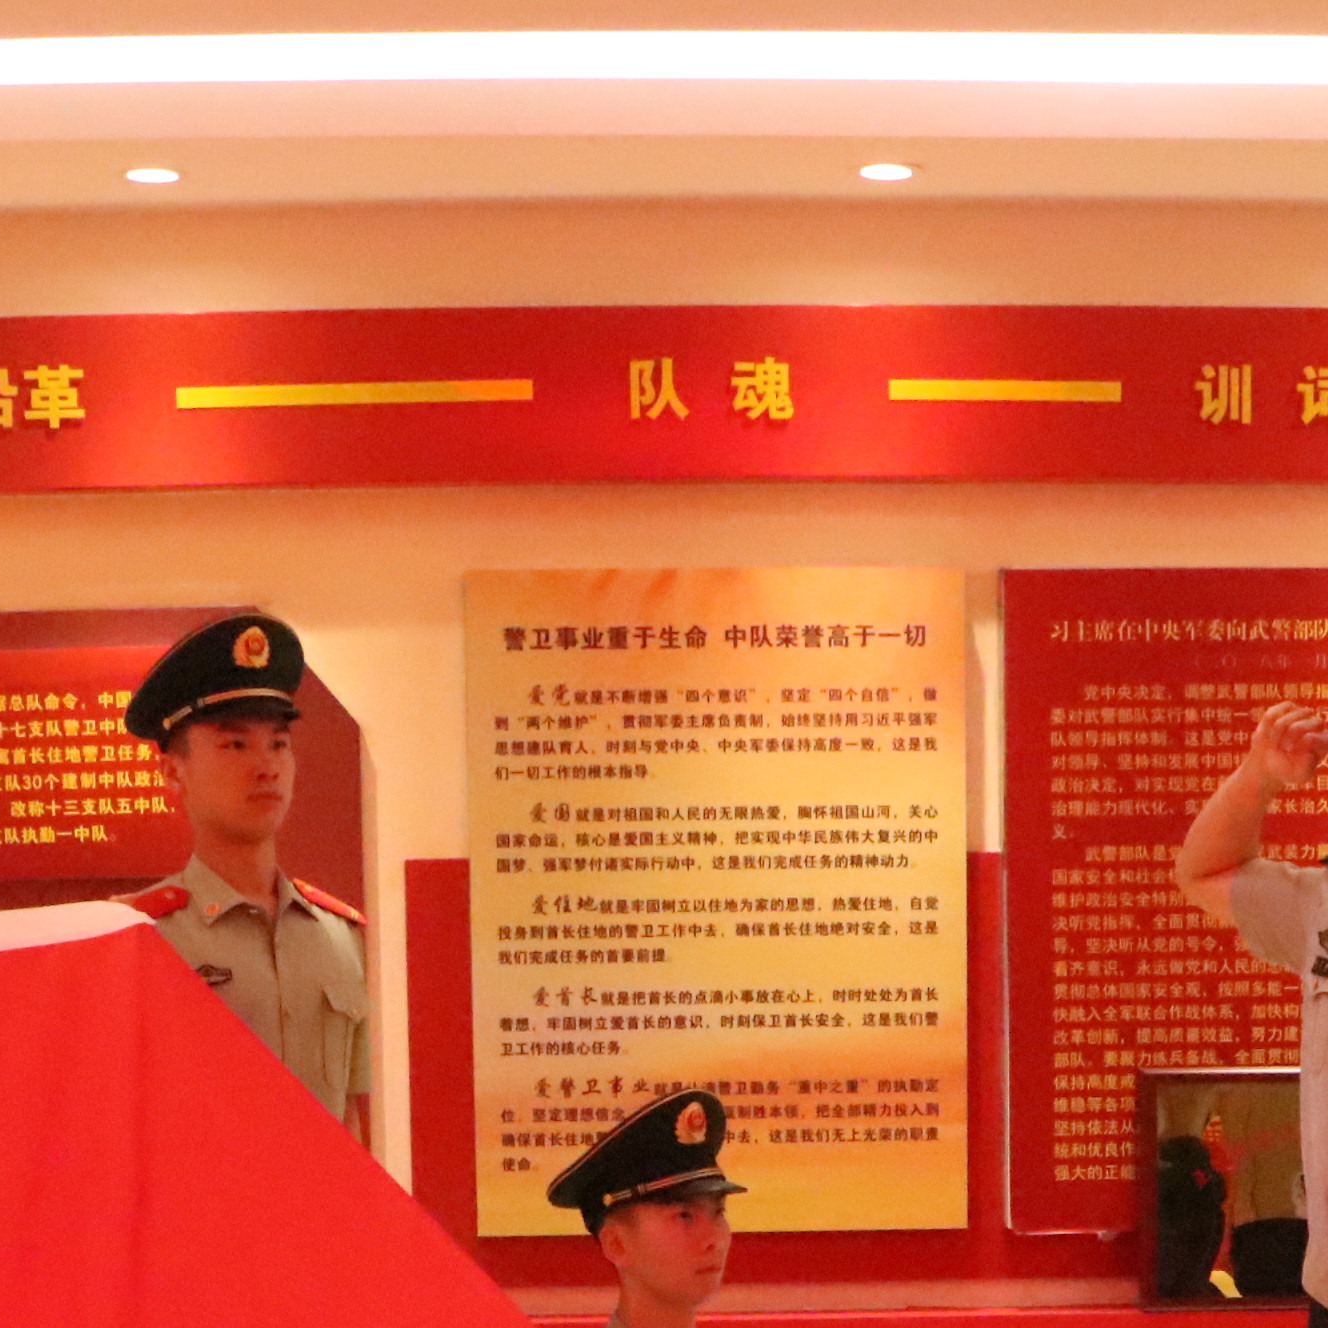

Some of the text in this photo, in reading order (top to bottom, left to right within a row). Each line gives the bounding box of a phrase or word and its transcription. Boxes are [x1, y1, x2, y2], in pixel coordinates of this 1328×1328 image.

[627, 357, 795, 424] 队魂
[503, 623, 928, 652] 警卫事业重于生命 中队荣誉高于一切
